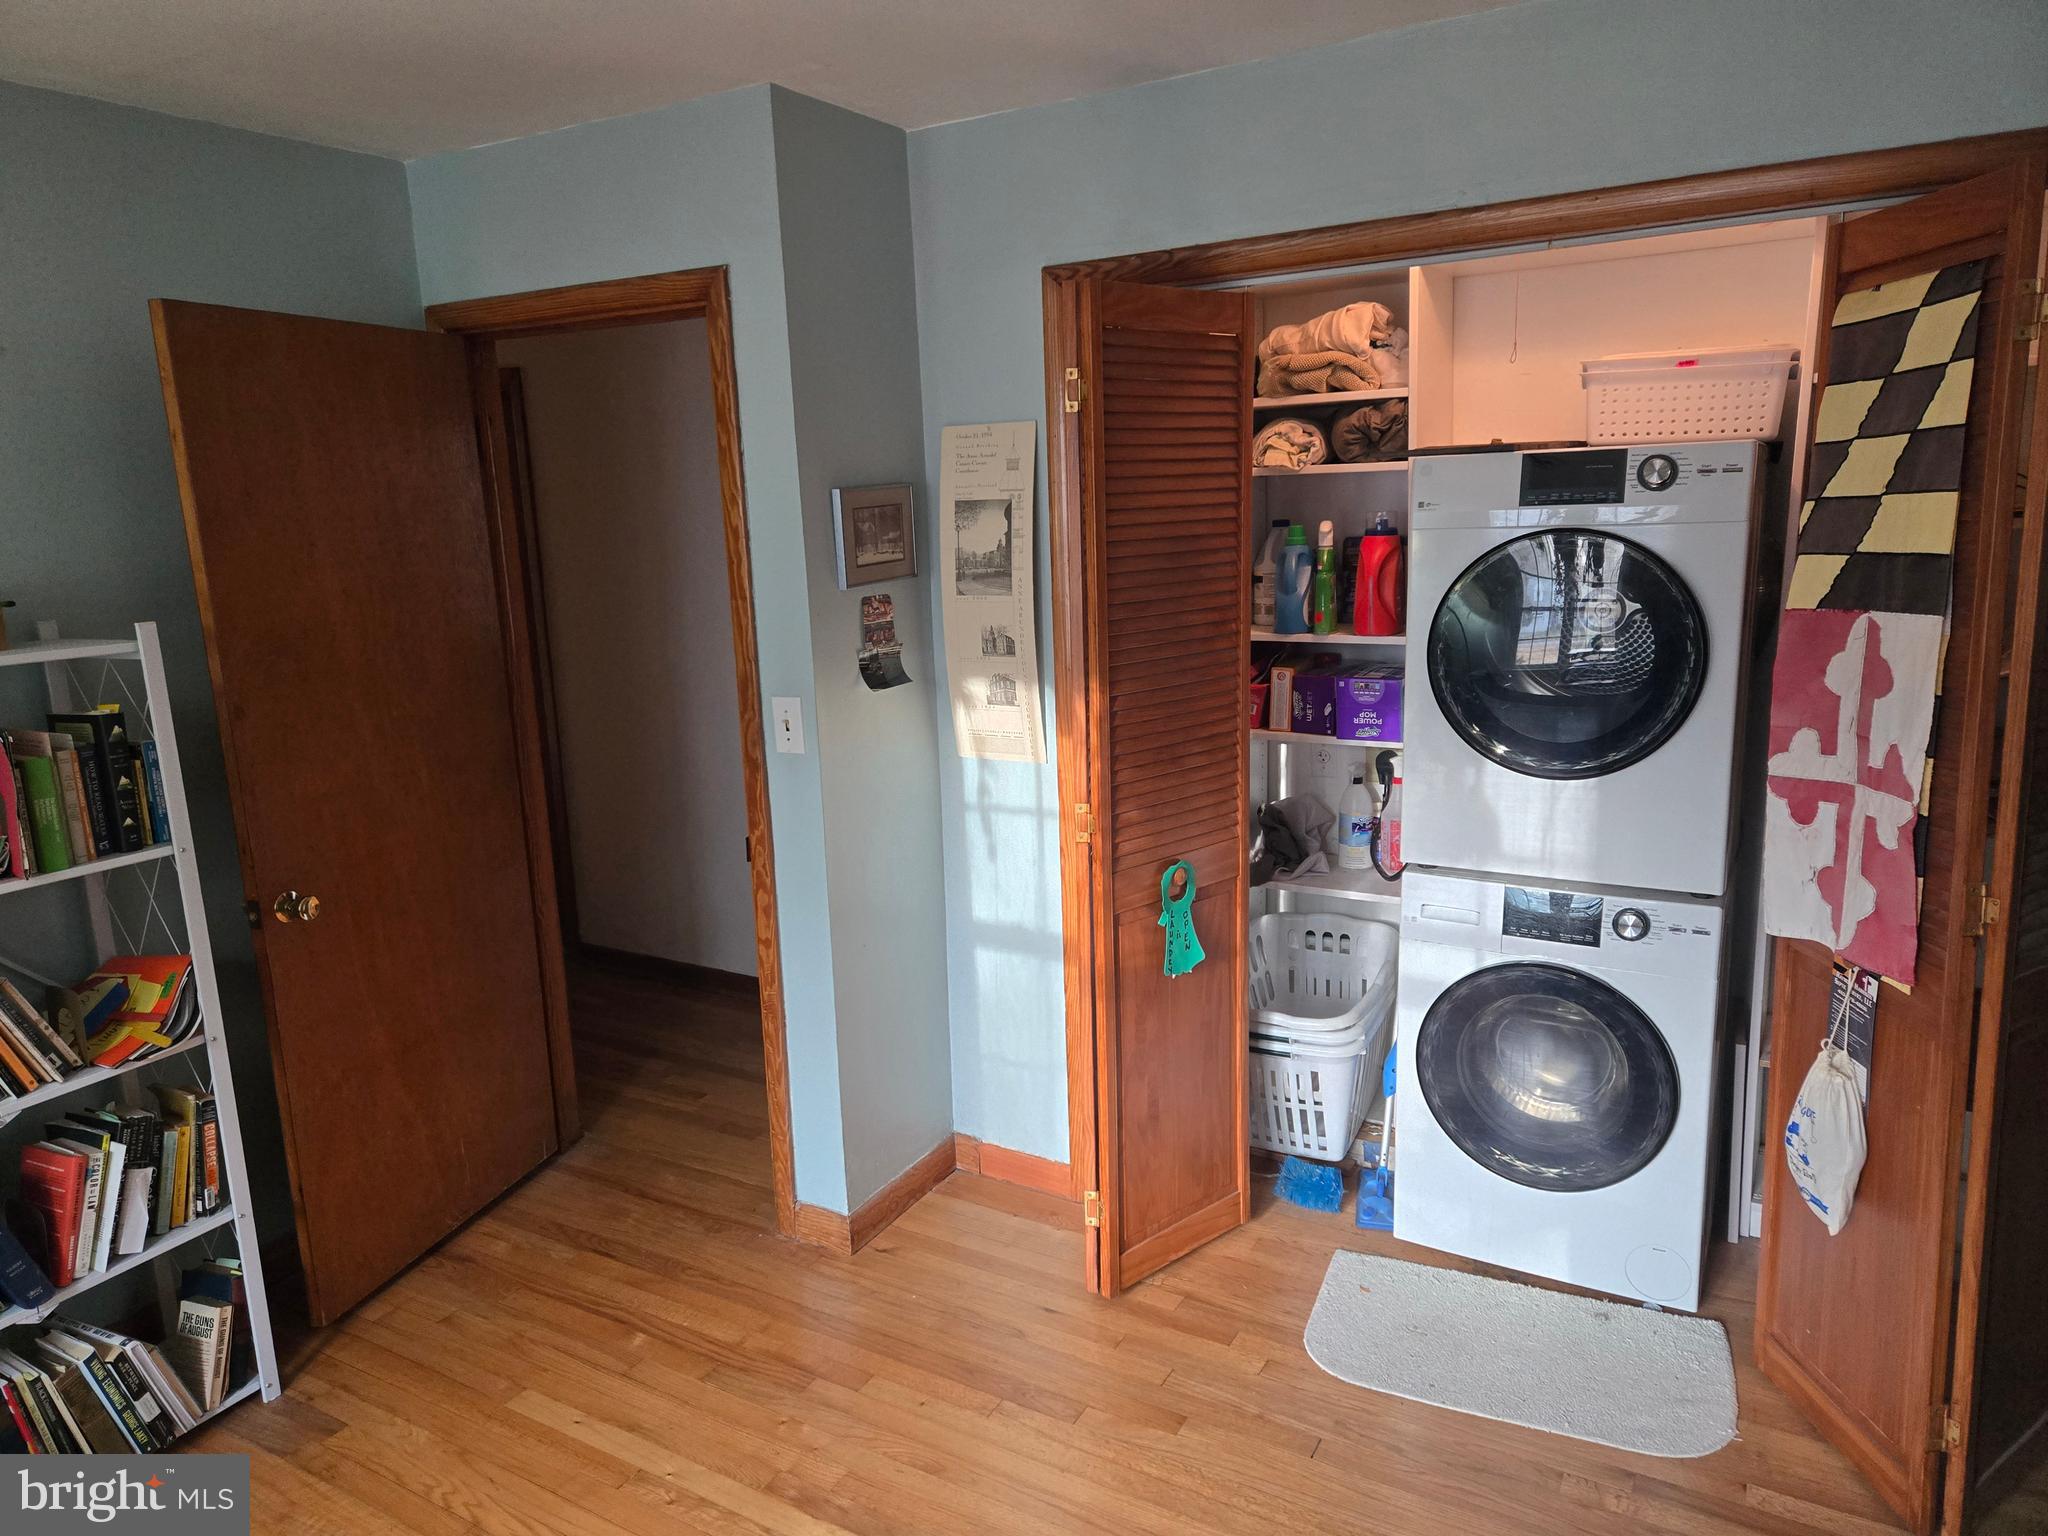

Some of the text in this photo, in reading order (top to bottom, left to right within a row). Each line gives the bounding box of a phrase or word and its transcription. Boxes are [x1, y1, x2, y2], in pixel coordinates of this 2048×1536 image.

[1182, 910, 1190, 950] OPEN
[202, 1123, 218, 1167] COLLAPSE
[89, 1165, 101, 1191] COLOR
[88, 1195, 98, 1212] LAW
[180, 1322, 214, 1339] OF AUGUST
[183, 1312, 215, 1328] THE GUNS
[220, 1315, 228, 1327] THE
[218, 1328, 226, 1347] GUNS
[90, 1358, 126, 1410] VIKING ECONOMICS
[122, 1409, 148, 1444] GEORGE LAKEY
